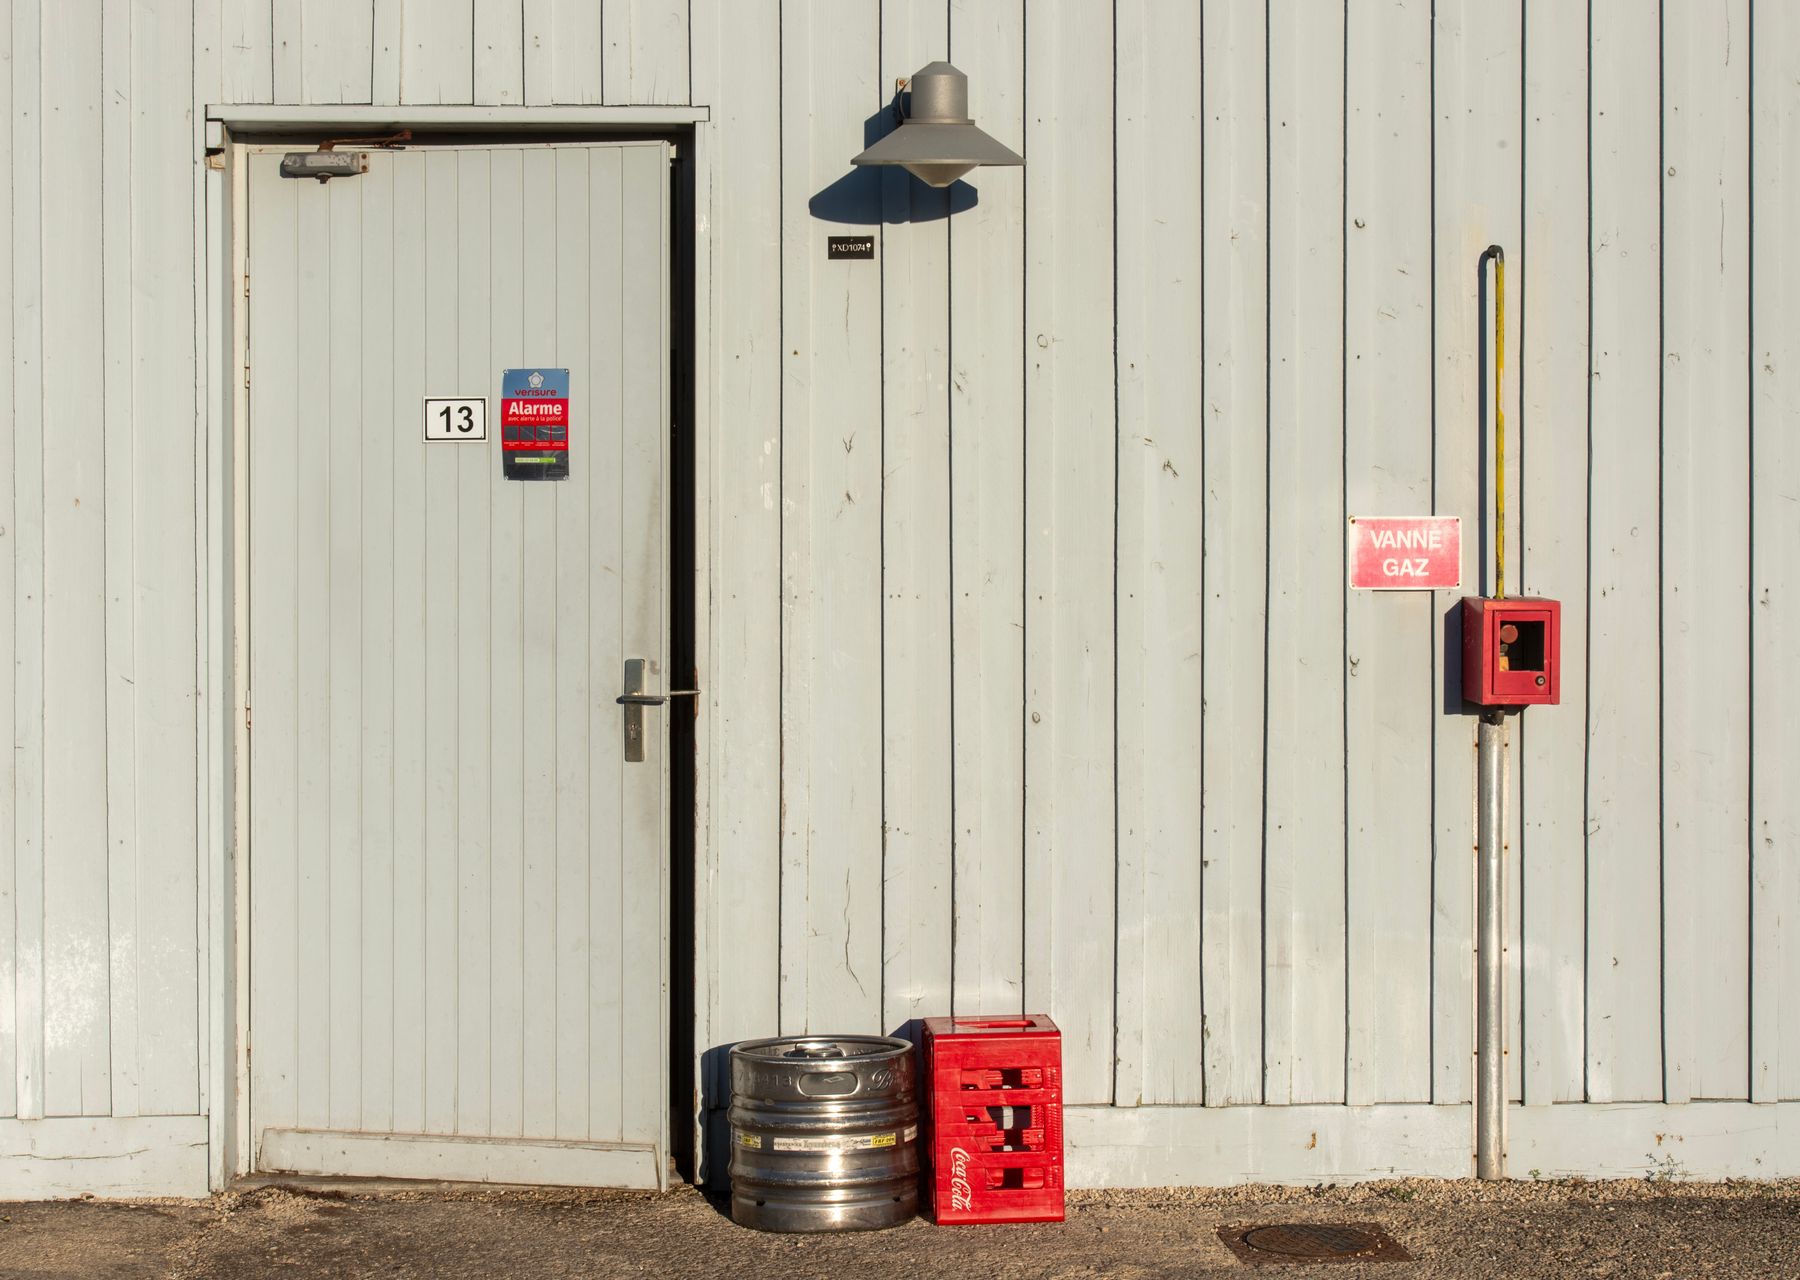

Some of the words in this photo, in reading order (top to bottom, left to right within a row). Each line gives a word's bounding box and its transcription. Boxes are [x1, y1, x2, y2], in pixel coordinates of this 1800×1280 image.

[439, 405, 474, 433] 13
[509, 401, 563, 416] Alarme
[1369, 529, 1443, 550] VANNE
[1382, 557, 1430, 578] GAZ
